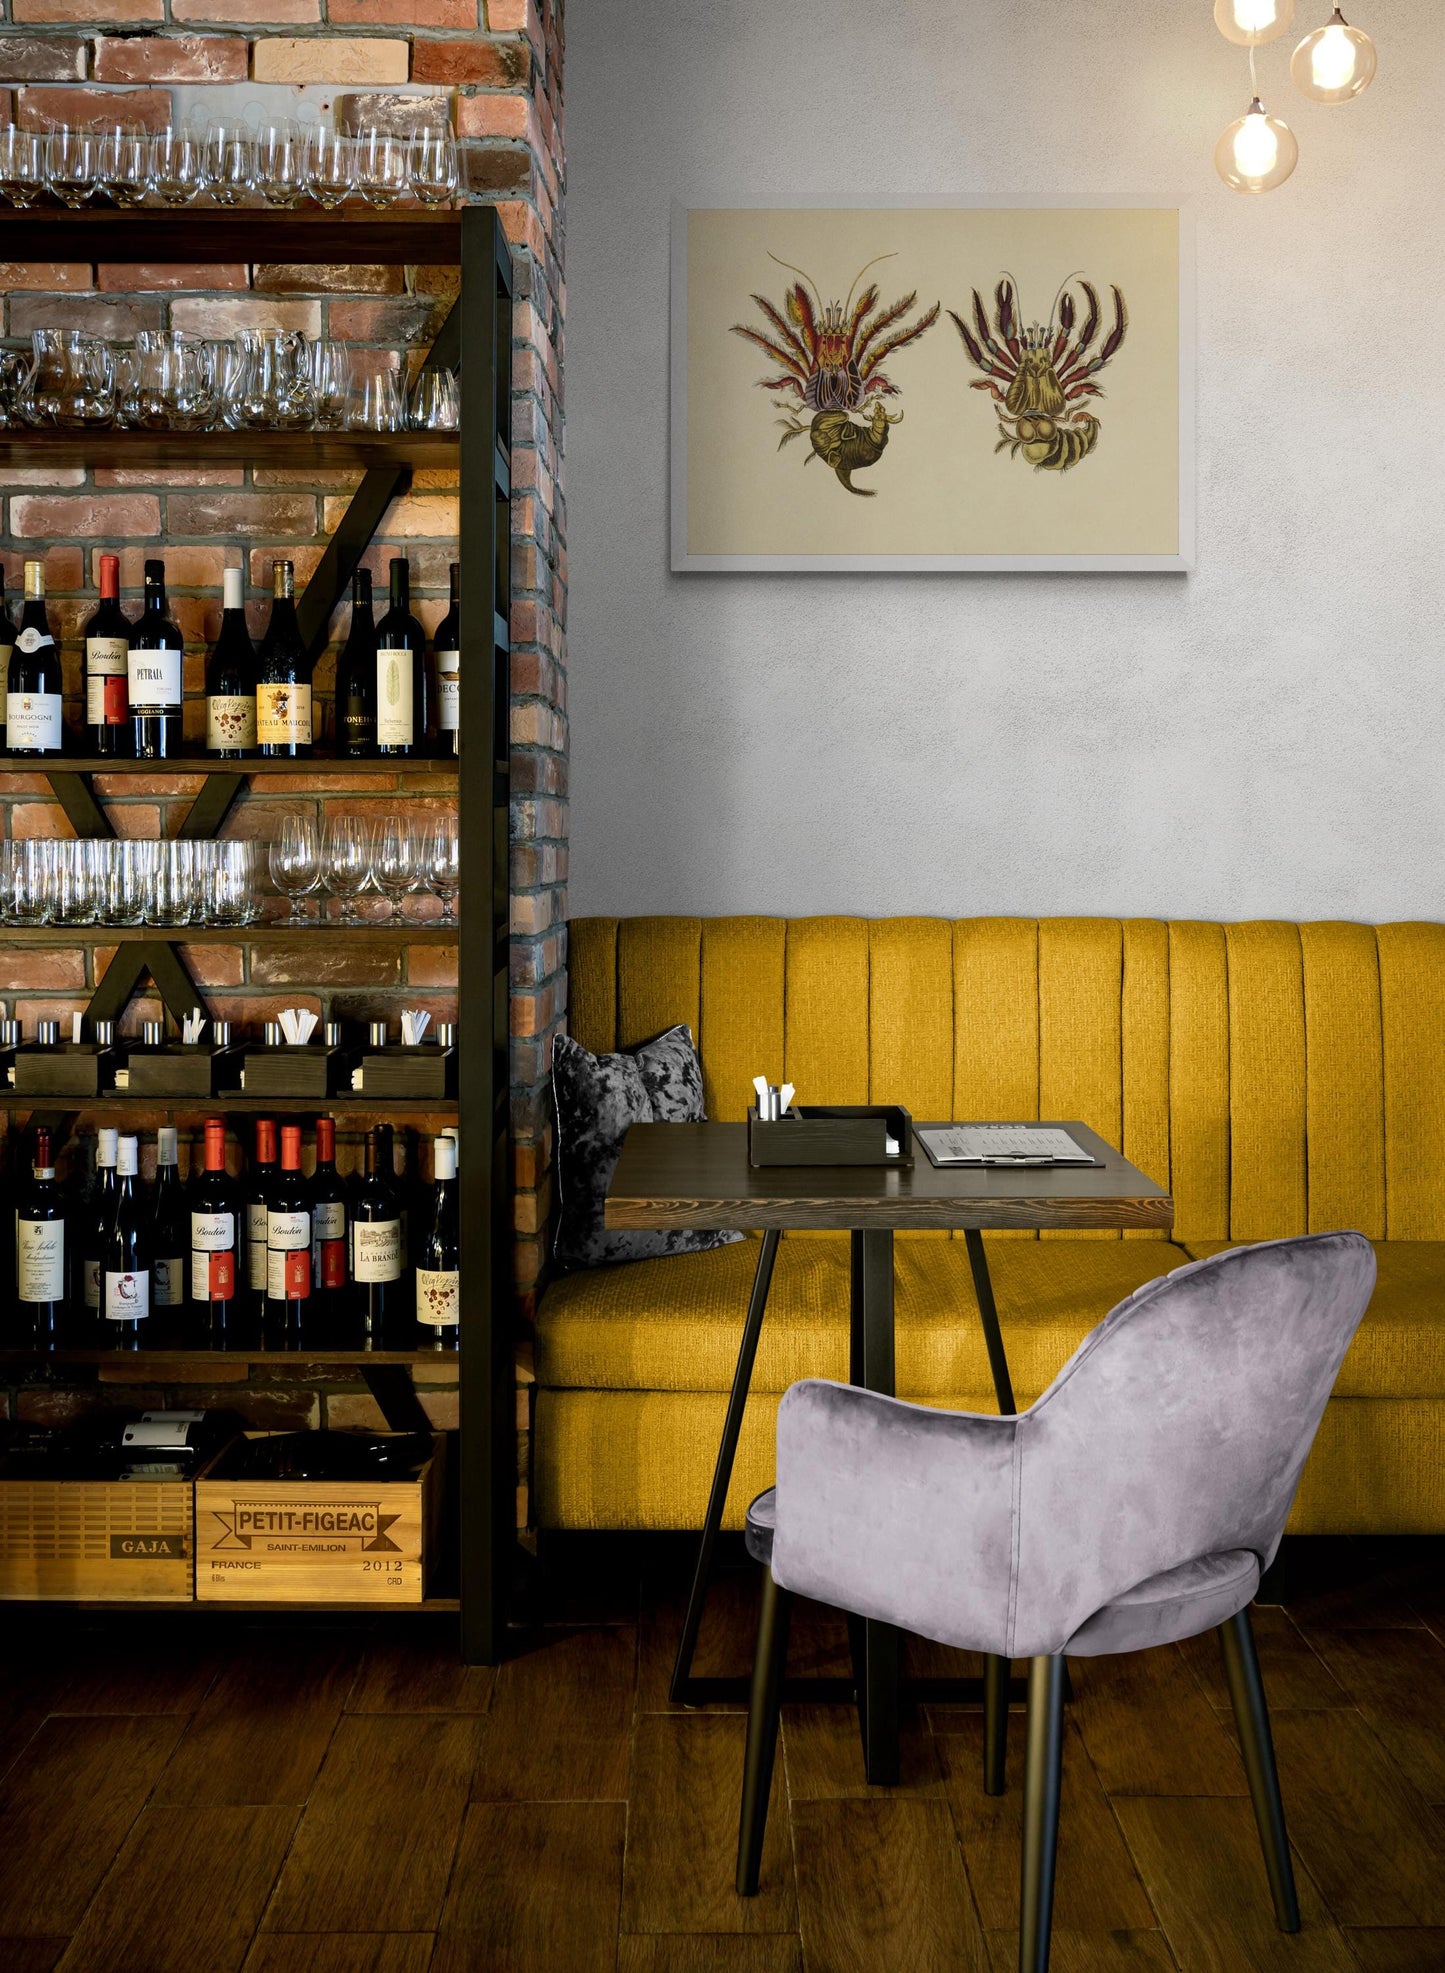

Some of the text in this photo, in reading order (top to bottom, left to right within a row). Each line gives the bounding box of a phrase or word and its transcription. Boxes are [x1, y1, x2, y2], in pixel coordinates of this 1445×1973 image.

[8, 713, 52, 721] BOURGOGNE
[196, 1226, 227, 1235] Bordón
[272, 1225, 302, 1235] Bordón
[239, 1511, 375, 1531] PETIT-FIGEAC
[121, 1540, 172, 1554] GAJA
[267, 1543, 347, 1552] SAINT-EMILION
[211, 1560, 262, 1570] FRANCE
[362, 1560, 403, 1571] 2012
[387, 1577, 403, 1585] CRD
